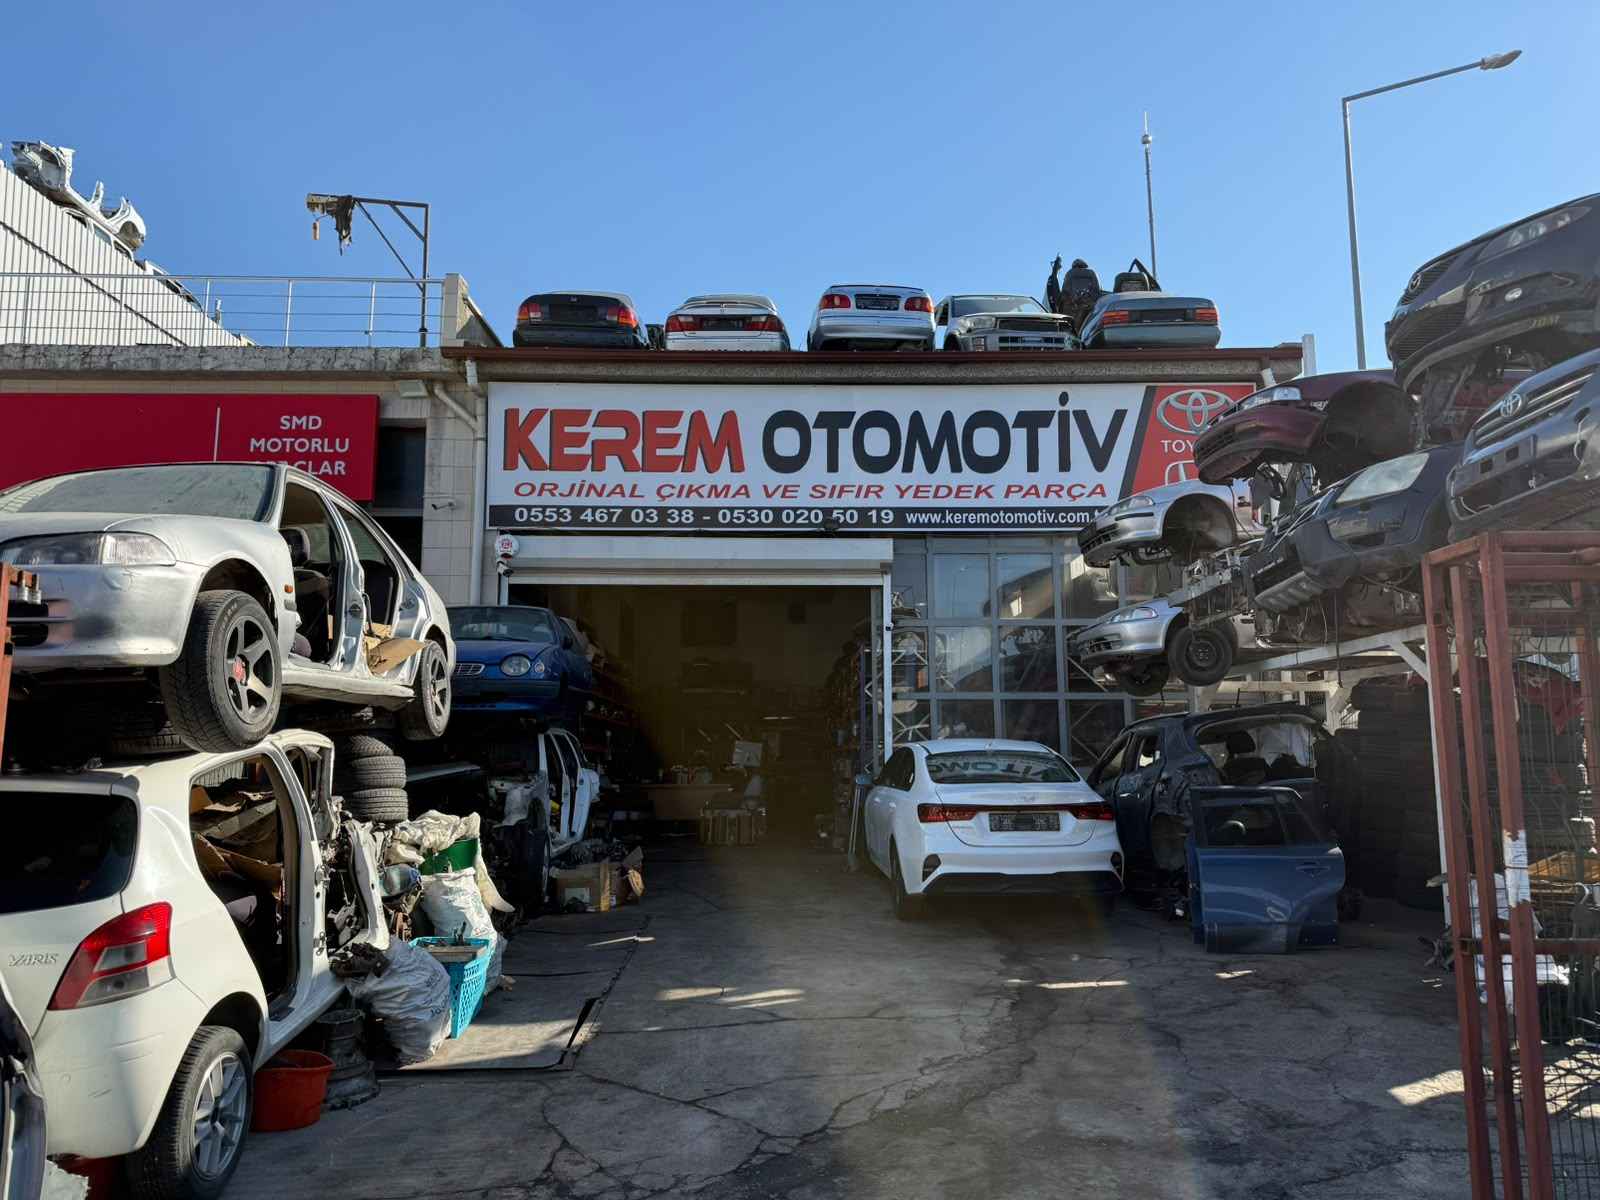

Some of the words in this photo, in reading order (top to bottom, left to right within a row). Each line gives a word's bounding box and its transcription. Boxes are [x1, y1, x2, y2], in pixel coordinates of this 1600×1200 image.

[280, 415, 322, 430] SMD
[503, 408, 746, 474] KEREM
[762, 391, 1128, 474] OTOMOTİV
[249, 438, 349, 452] MOTORLU
[1160, 439, 1196, 453] TOY
[513, 479, 646, 499] ORJİNAL
[656, 483, 752, 502] ÇIKMA
[762, 483, 801, 499] VE
[809, 484, 885, 499] SIFIR
[895, 484, 995, 500] YEDEK
[1003, 484, 1108, 502] PARÇA
[514, 507, 572, 523] 0553
[579, 507, 622, 523] 467
[631, 508, 659, 523] 03
[666, 508, 694, 524] 38
[718, 509, 773, 524] 0530
[781, 509, 823, 524] 020
[832, 509, 859, 524] 50
[867, 510, 894, 524] 19
